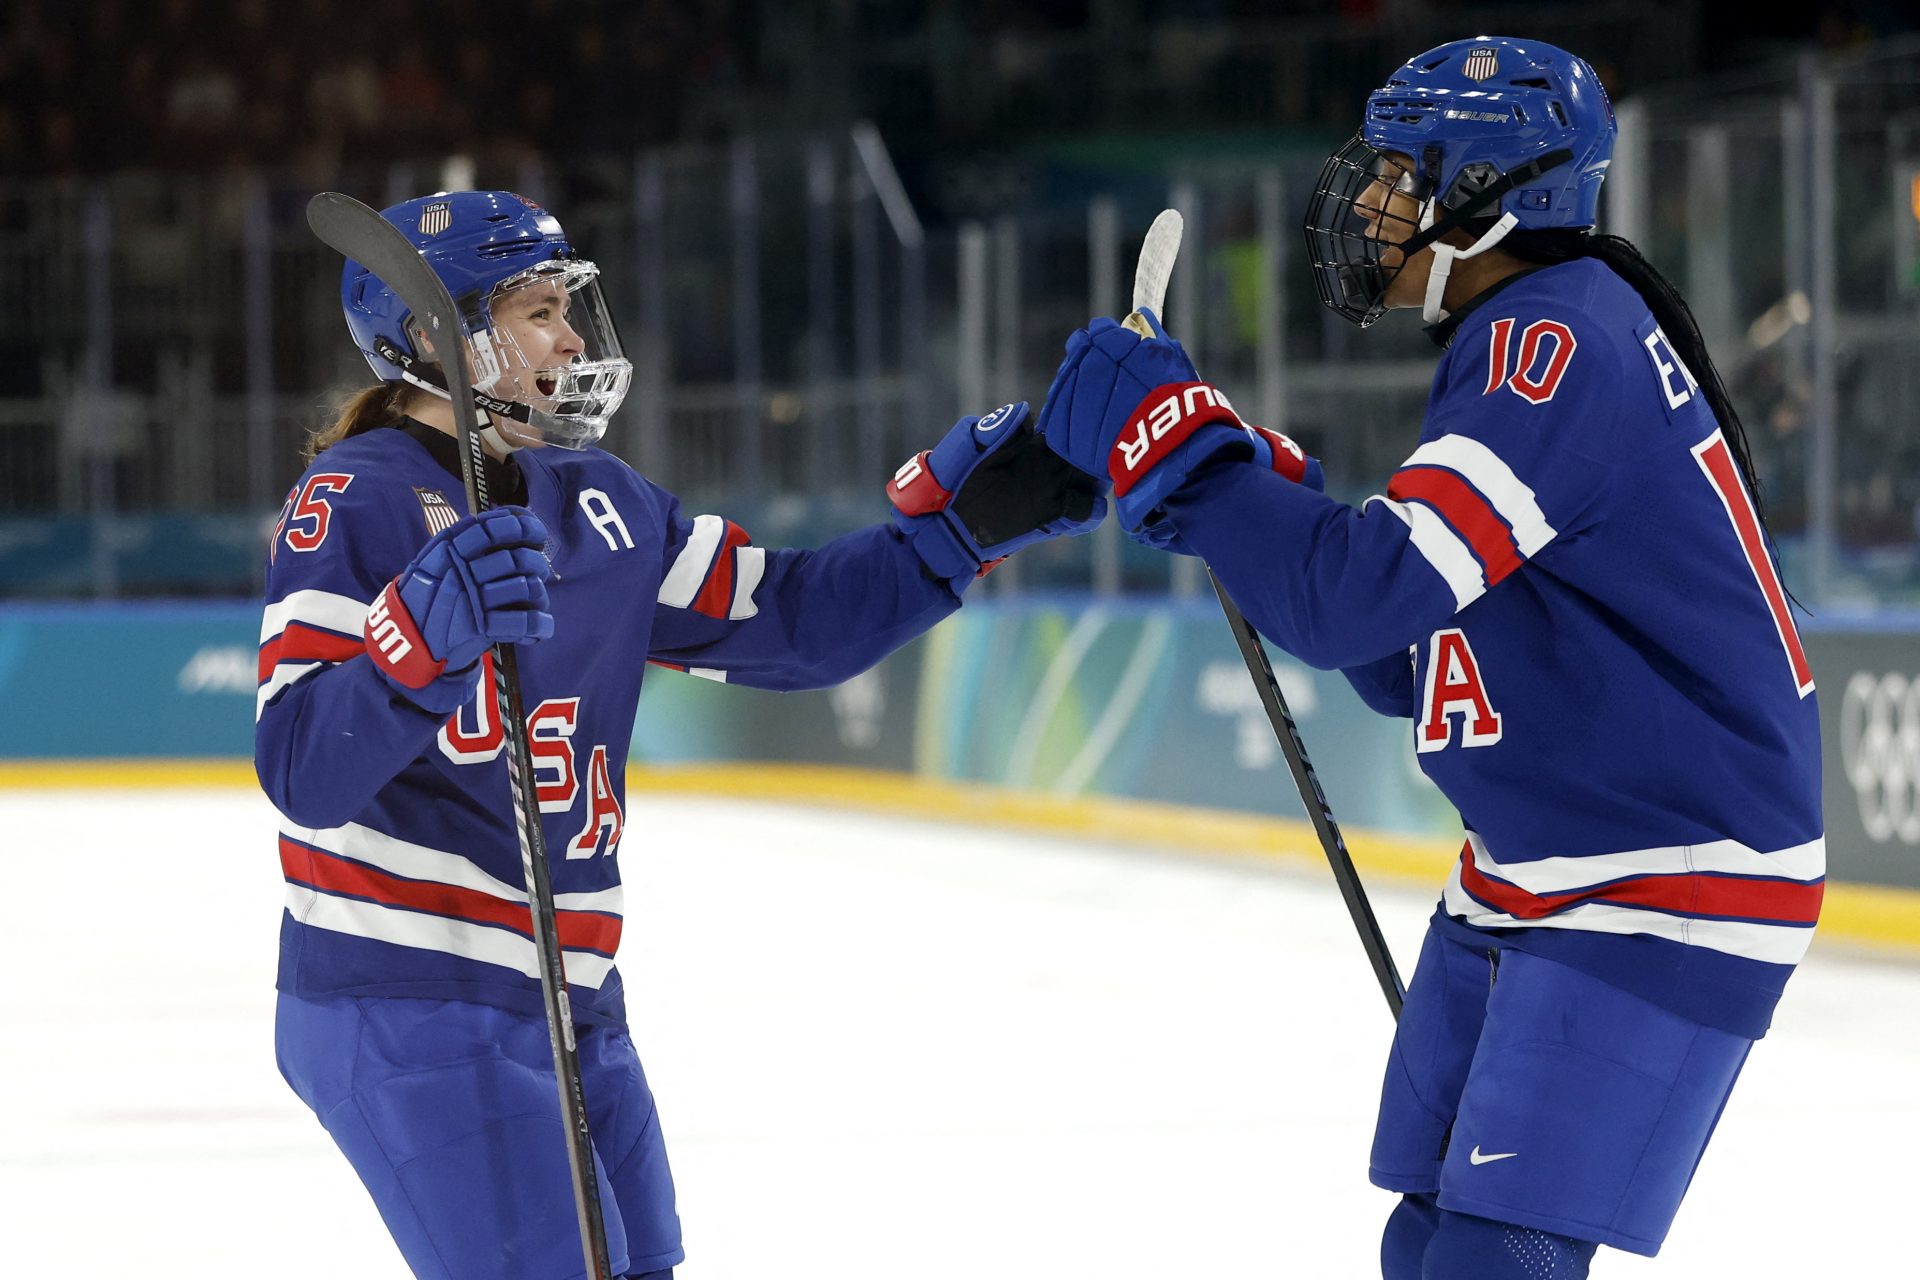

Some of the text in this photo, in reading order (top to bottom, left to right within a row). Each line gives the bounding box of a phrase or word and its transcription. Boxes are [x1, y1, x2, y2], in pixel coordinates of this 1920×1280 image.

[1444, 110, 1510, 123] BAUER
[426, 203, 446, 213] USA
[1483, 317, 1578, 405] 10
[421, 492, 446, 504] USA
[578, 487, 636, 552] A
[1409, 628, 1503, 754] A
